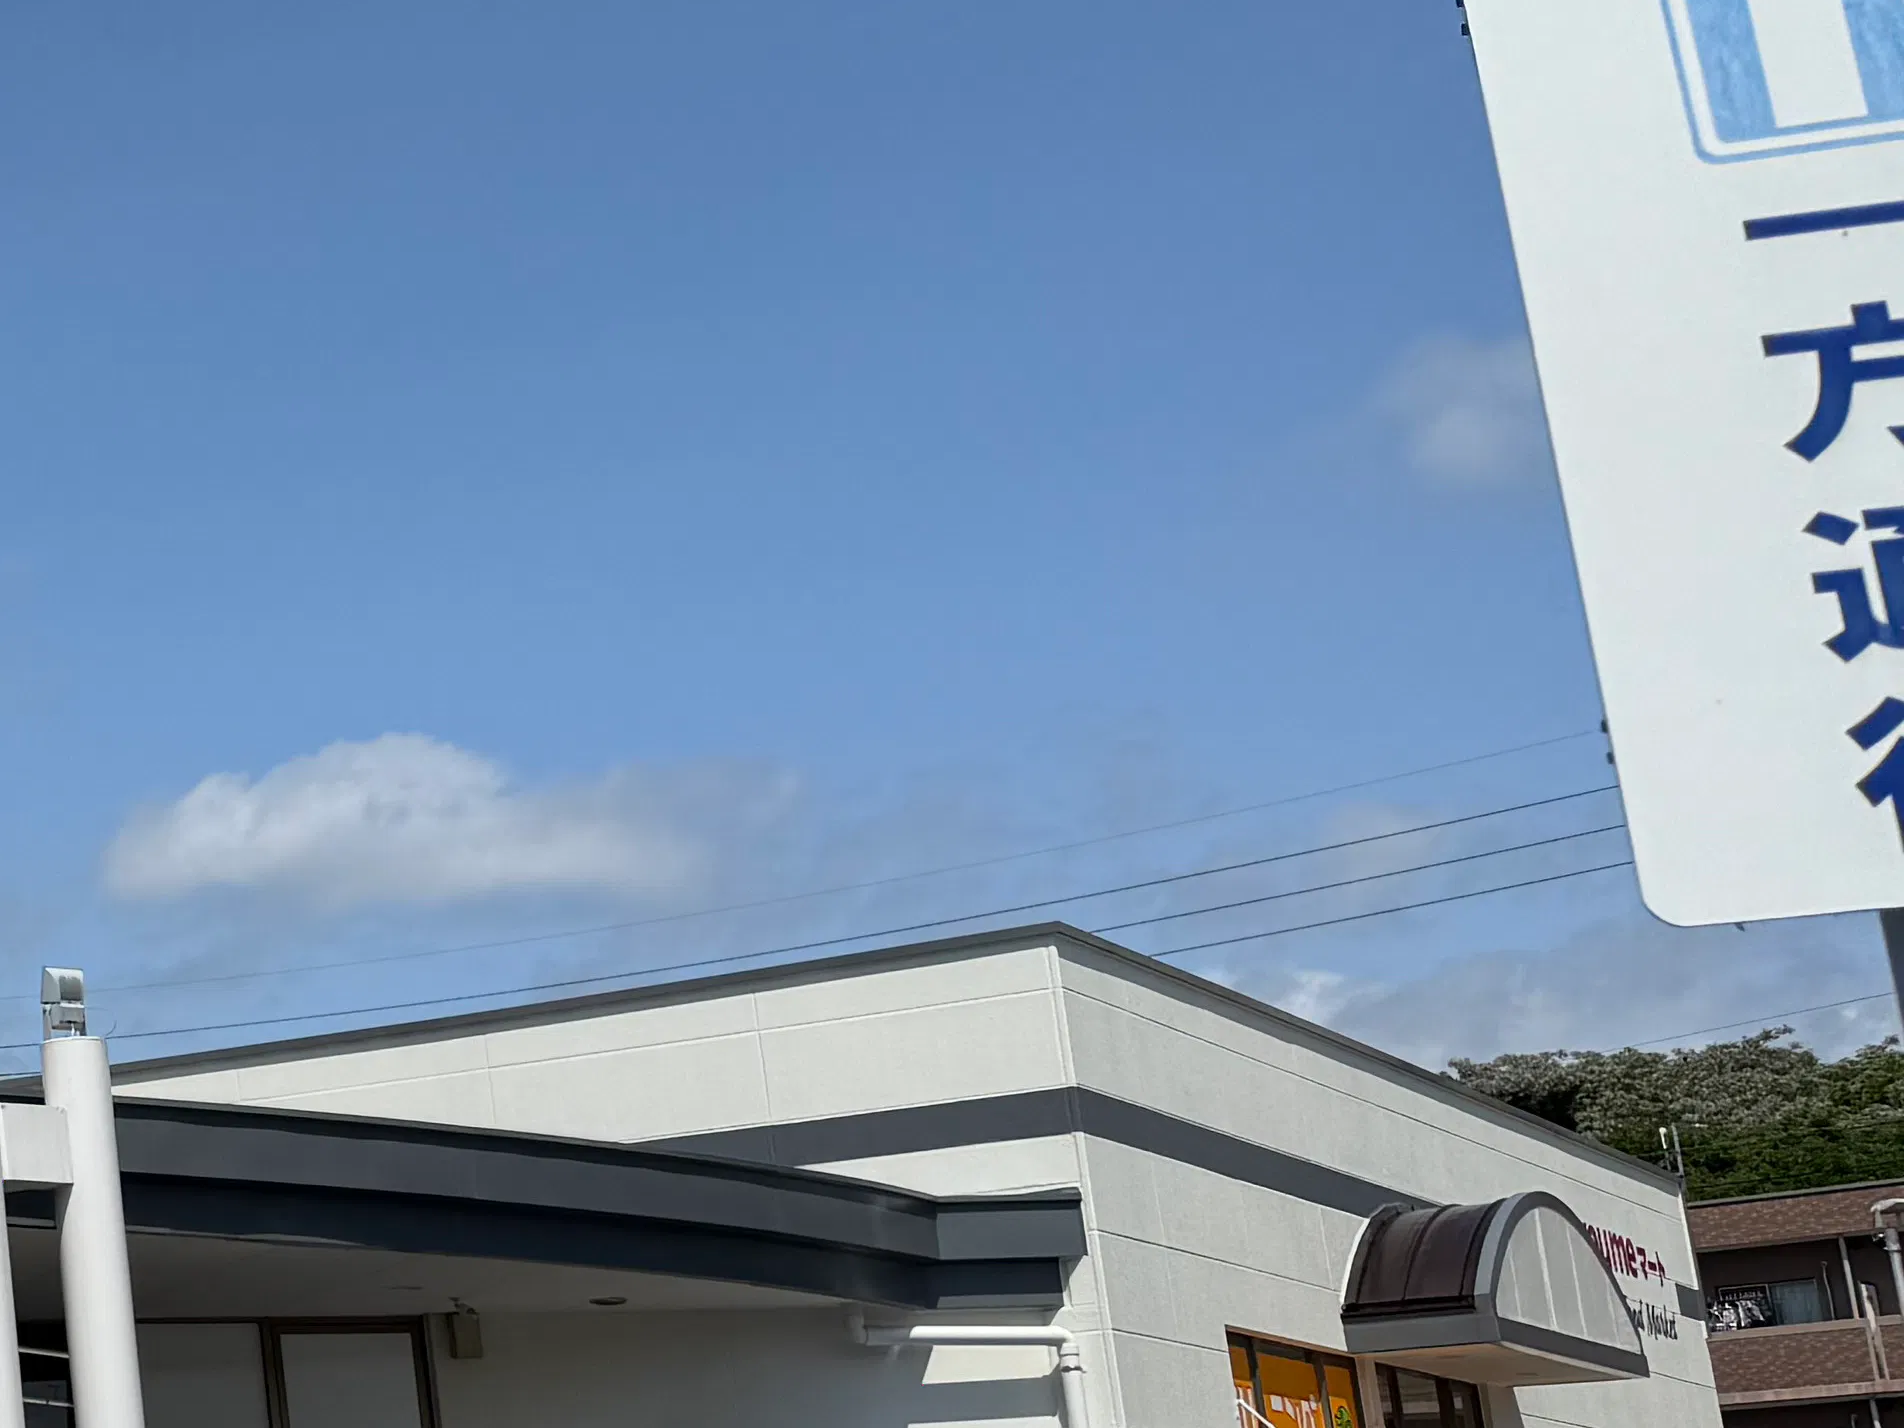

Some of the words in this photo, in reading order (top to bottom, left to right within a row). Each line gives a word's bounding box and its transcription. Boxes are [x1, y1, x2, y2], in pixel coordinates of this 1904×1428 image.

[1743, 201, 1904, 851] 一方
[1636, 1246, 1666, 1287] マート
